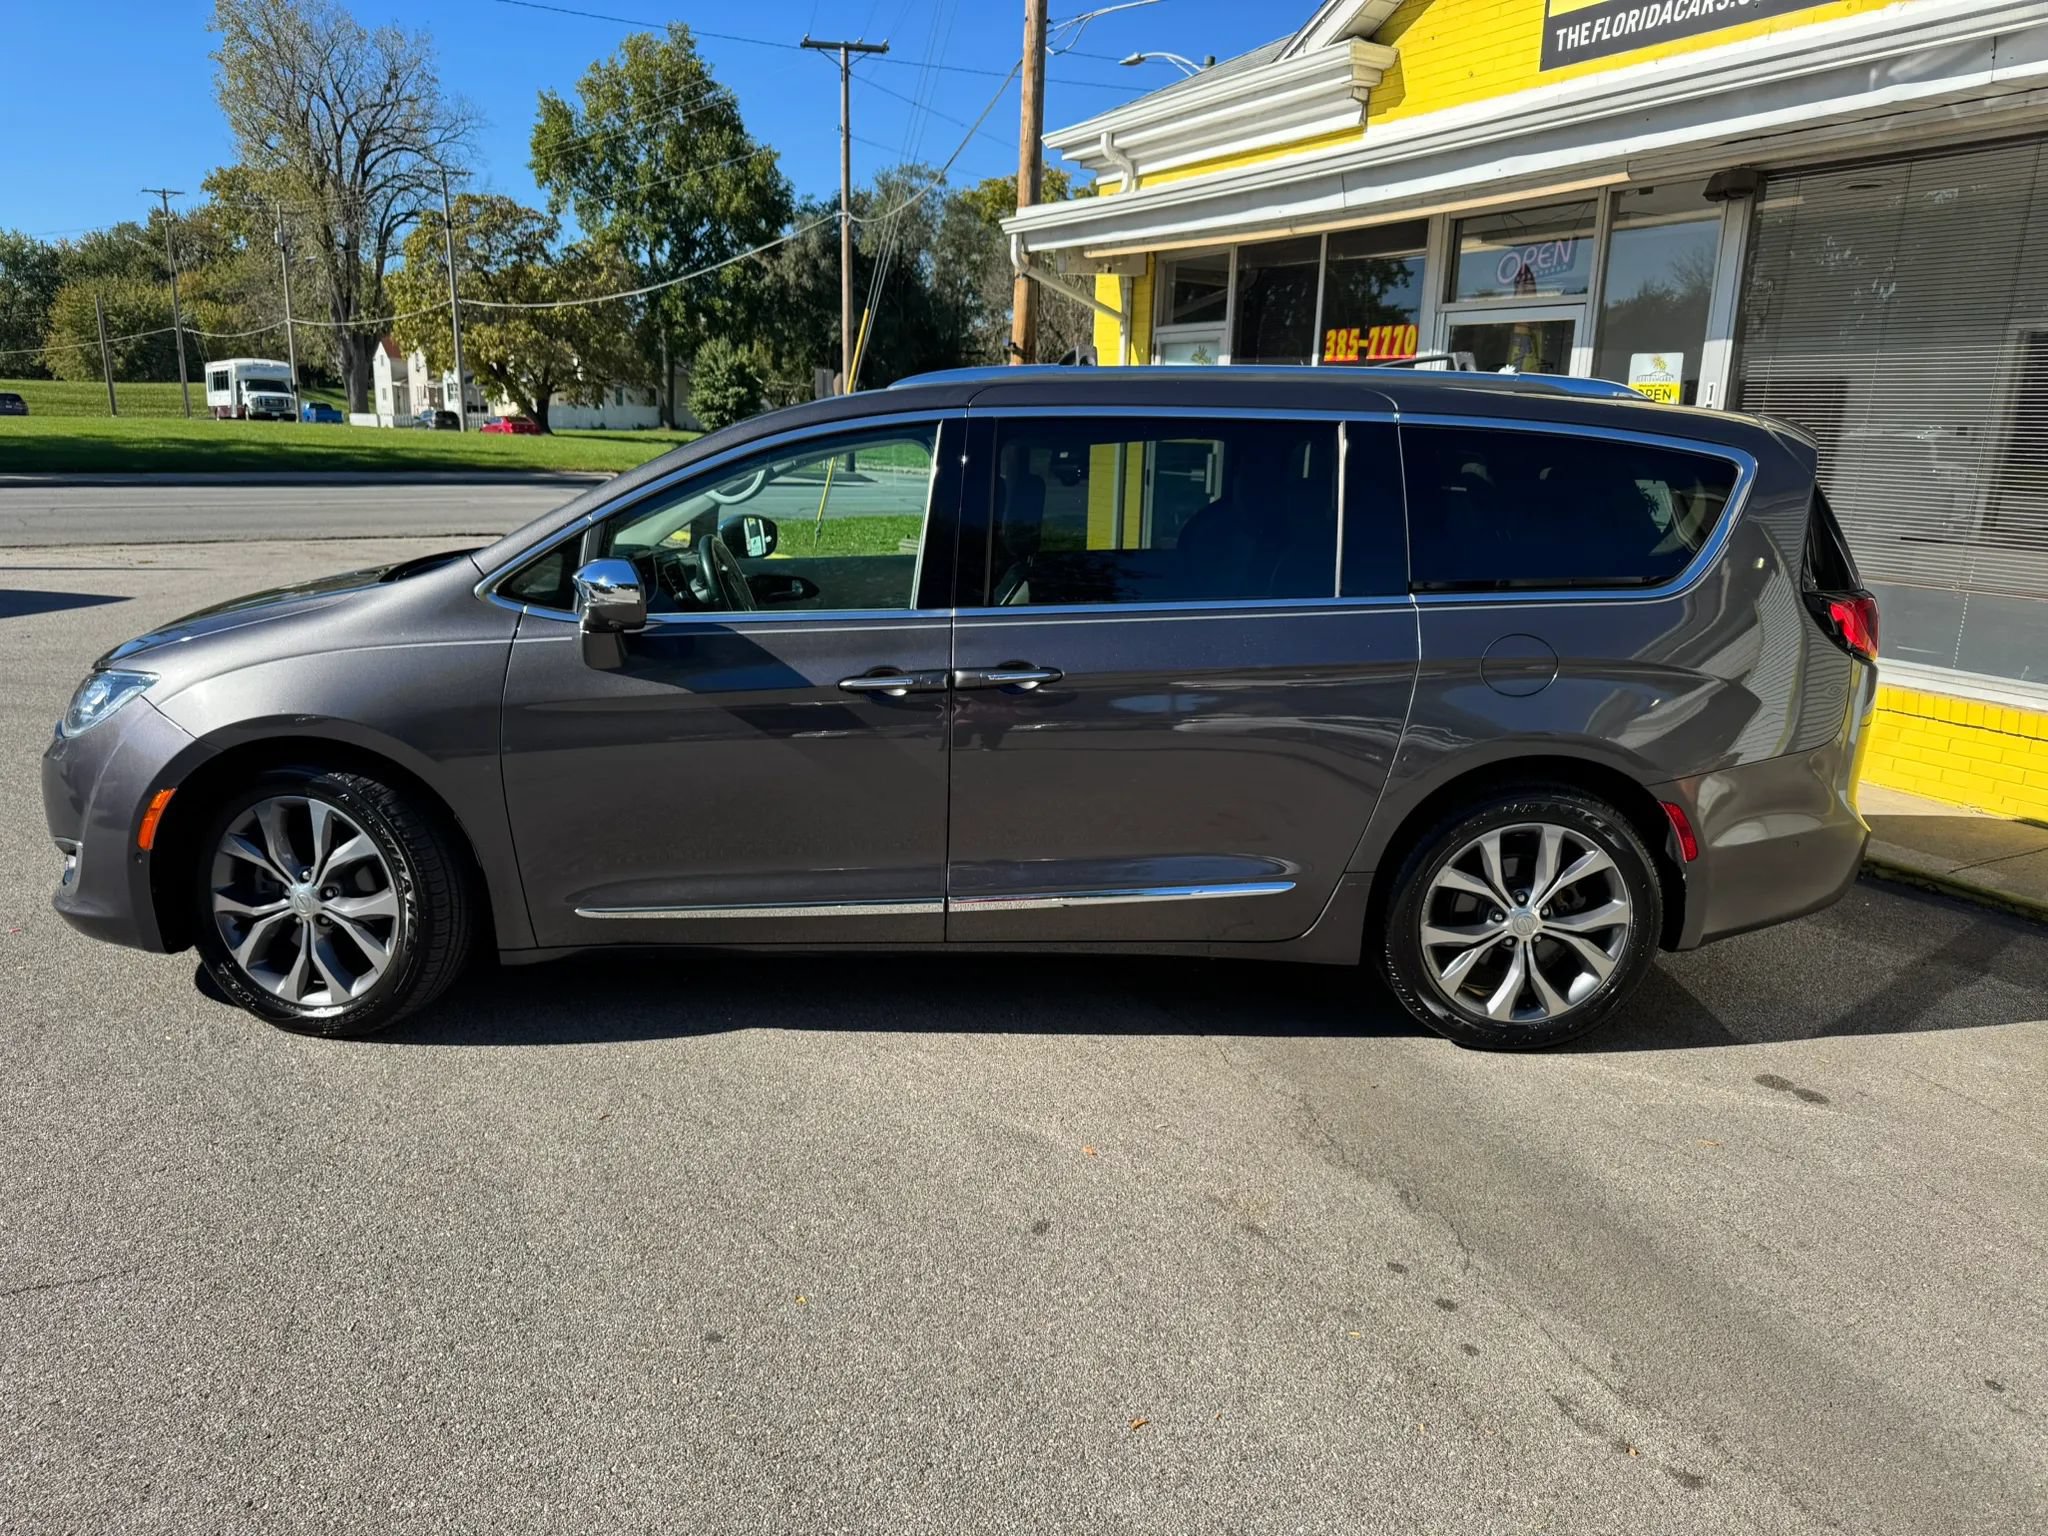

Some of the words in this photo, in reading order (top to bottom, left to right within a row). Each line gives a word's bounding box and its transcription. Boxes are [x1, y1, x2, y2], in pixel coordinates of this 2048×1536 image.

[1556, 0, 1751, 52] THEFLORIDACAR.
[1497, 237, 1573, 284] OPEN
[1323, 324, 1417, 361] 385-7770
